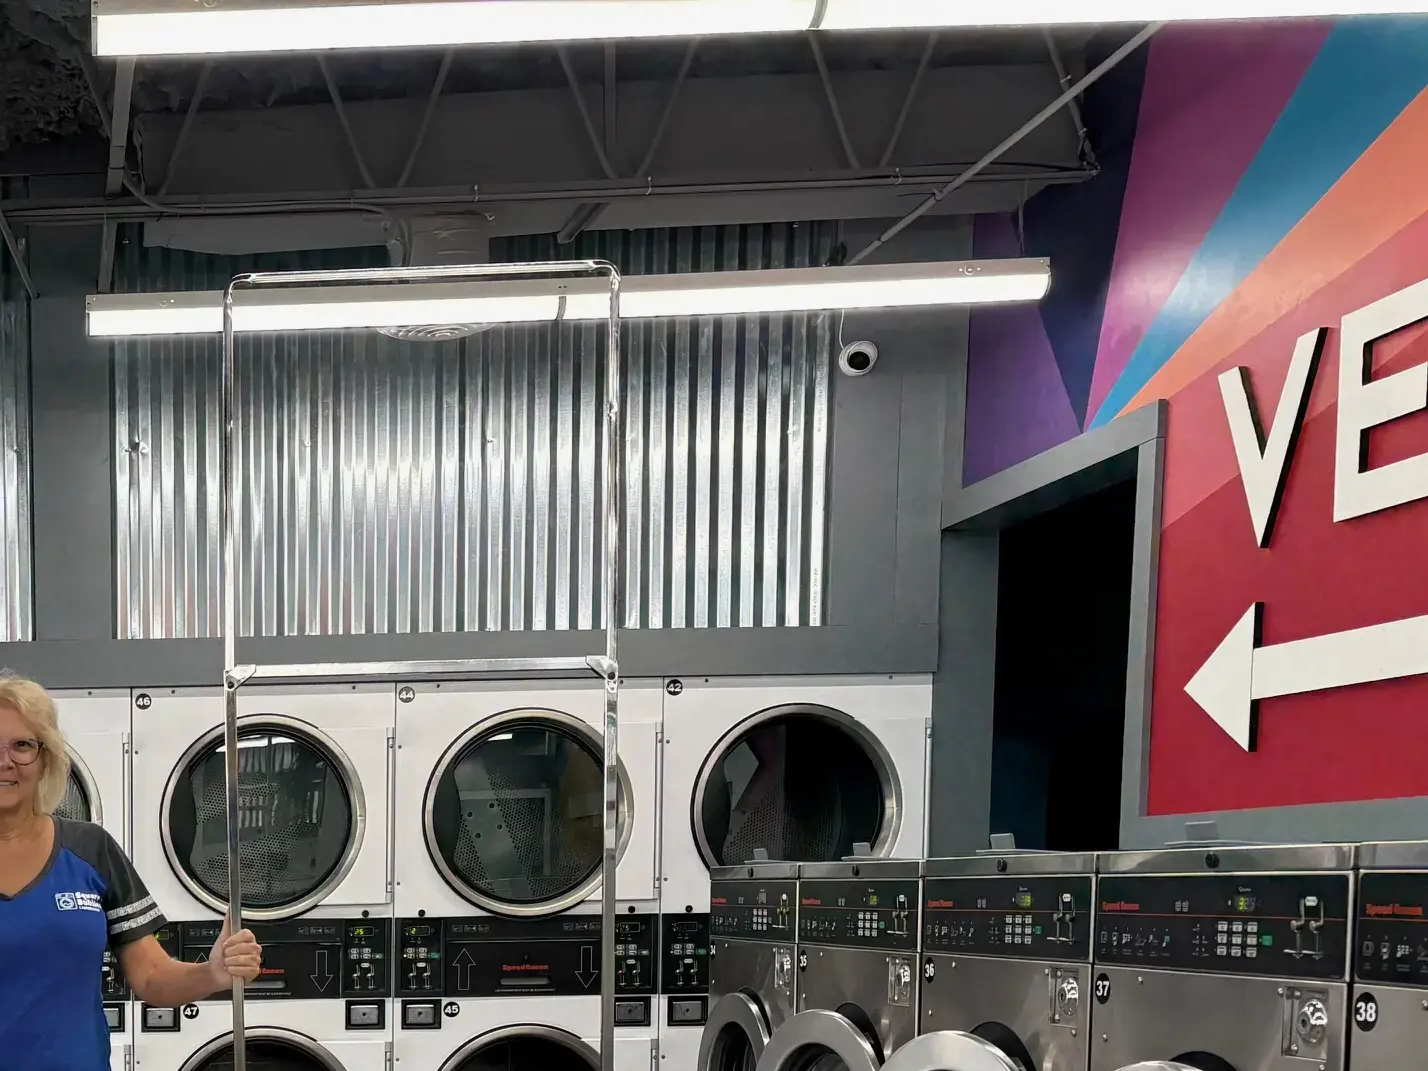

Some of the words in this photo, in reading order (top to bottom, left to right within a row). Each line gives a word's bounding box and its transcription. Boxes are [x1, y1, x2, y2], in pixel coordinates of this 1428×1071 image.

[667, 683, 682, 692] 42
[400, 690, 414, 699] 44
[136, 697, 151, 706] 46
[799, 955, 808, 967] 35
[924, 963, 935, 977] 36
[1096, 980, 1110, 997] 37
[183, 1006, 198, 1016] 47
[444, 1004, 459, 1014] 45
[1355, 1002, 1377, 1022] 38
